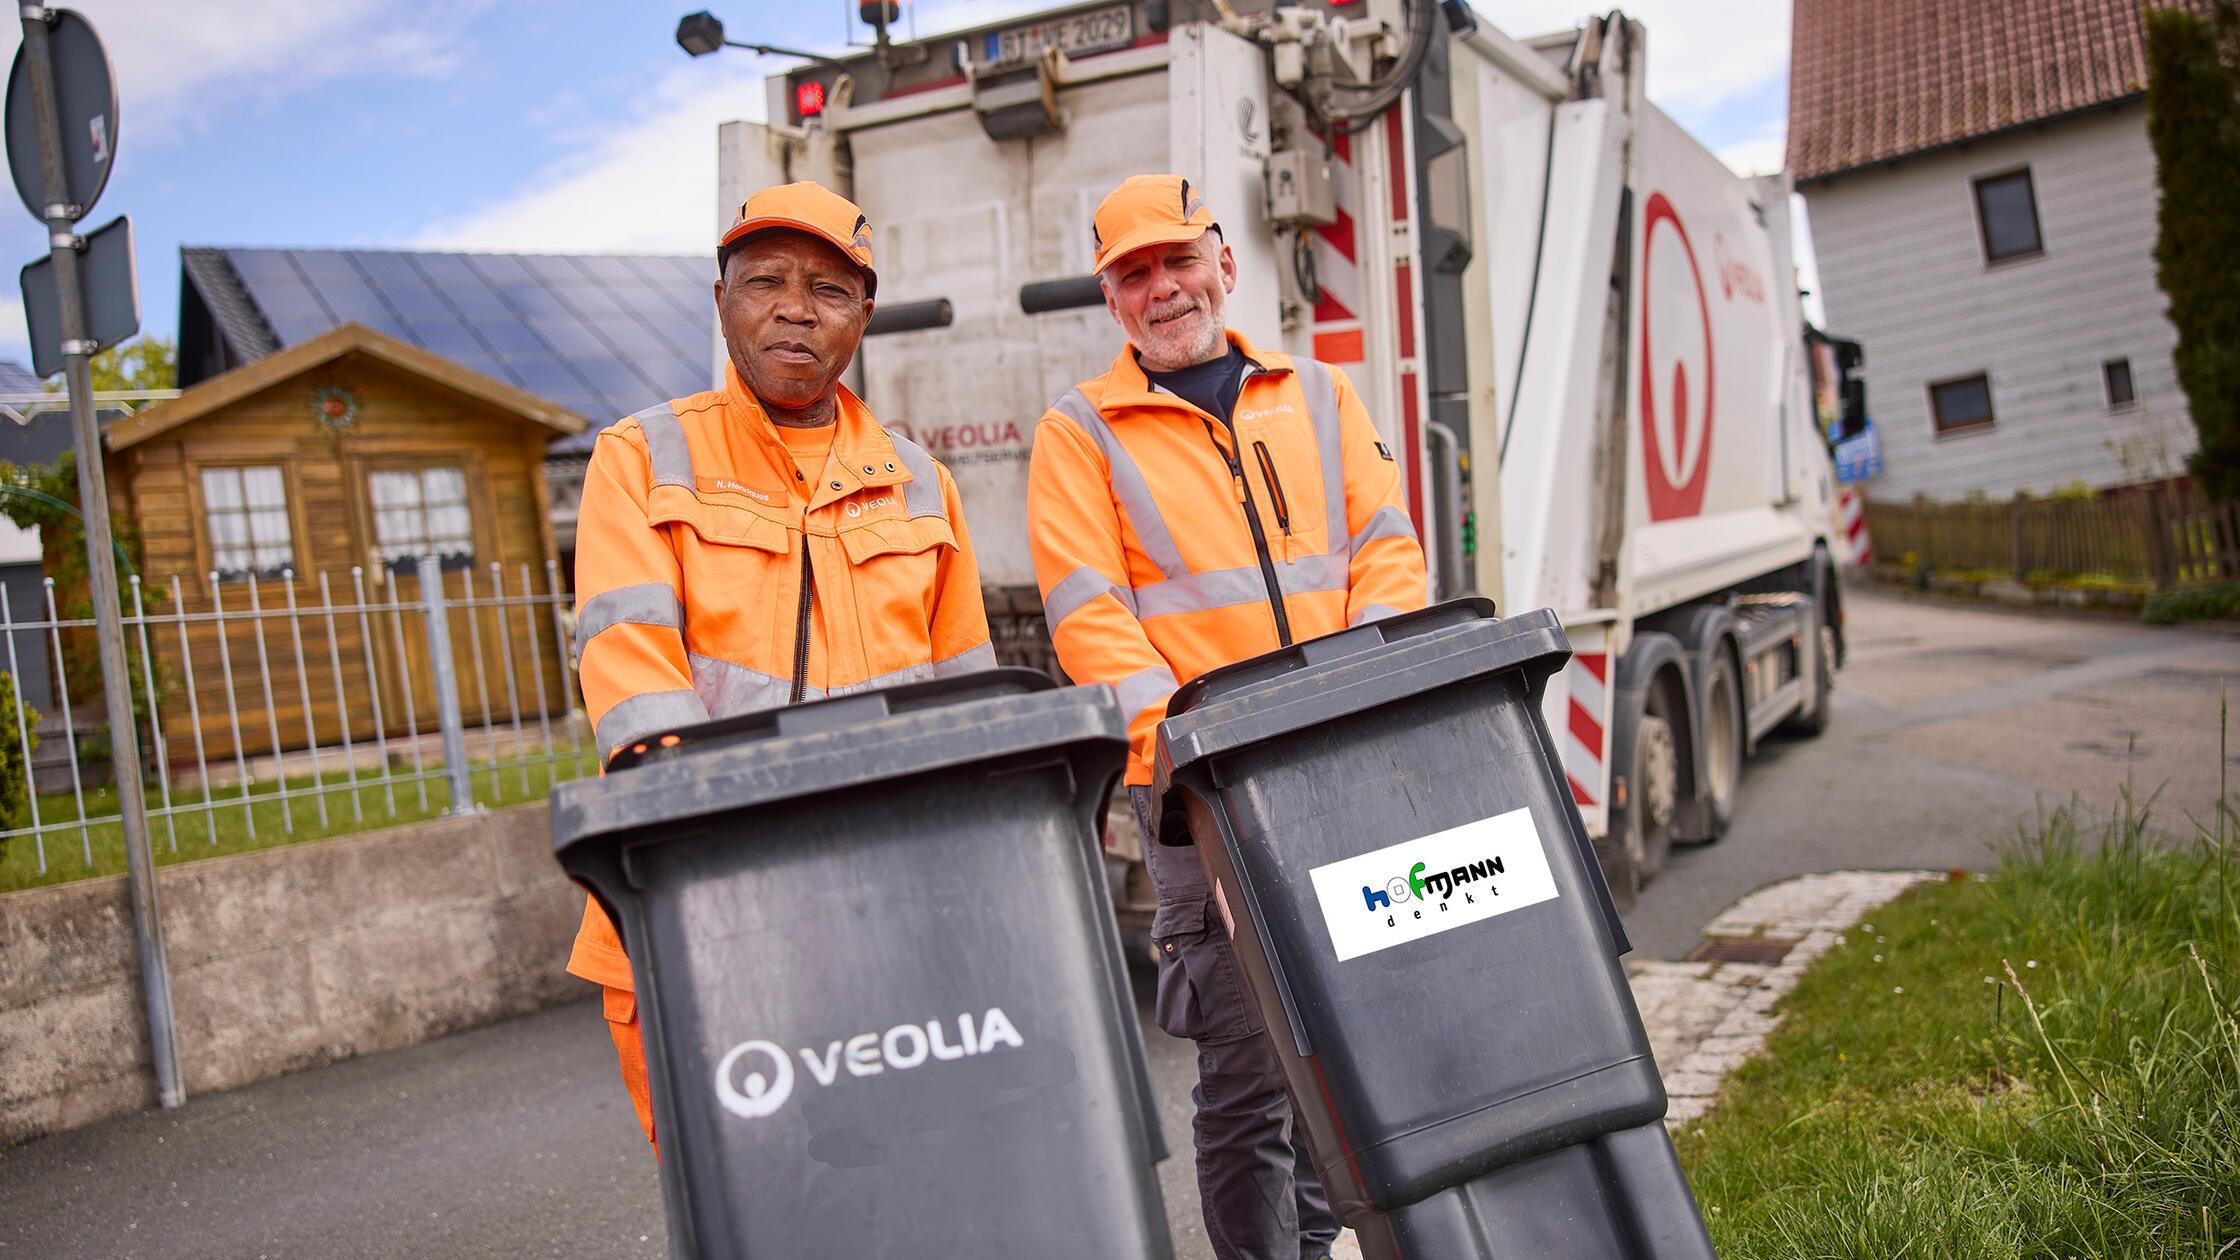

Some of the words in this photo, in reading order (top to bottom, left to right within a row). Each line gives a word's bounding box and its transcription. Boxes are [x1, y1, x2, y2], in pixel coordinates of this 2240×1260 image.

[1073, 10, 1125, 45] 2029
[921, 421, 1021, 449] VEOLIA
[799, 1007, 1024, 1086] VEOLIA
